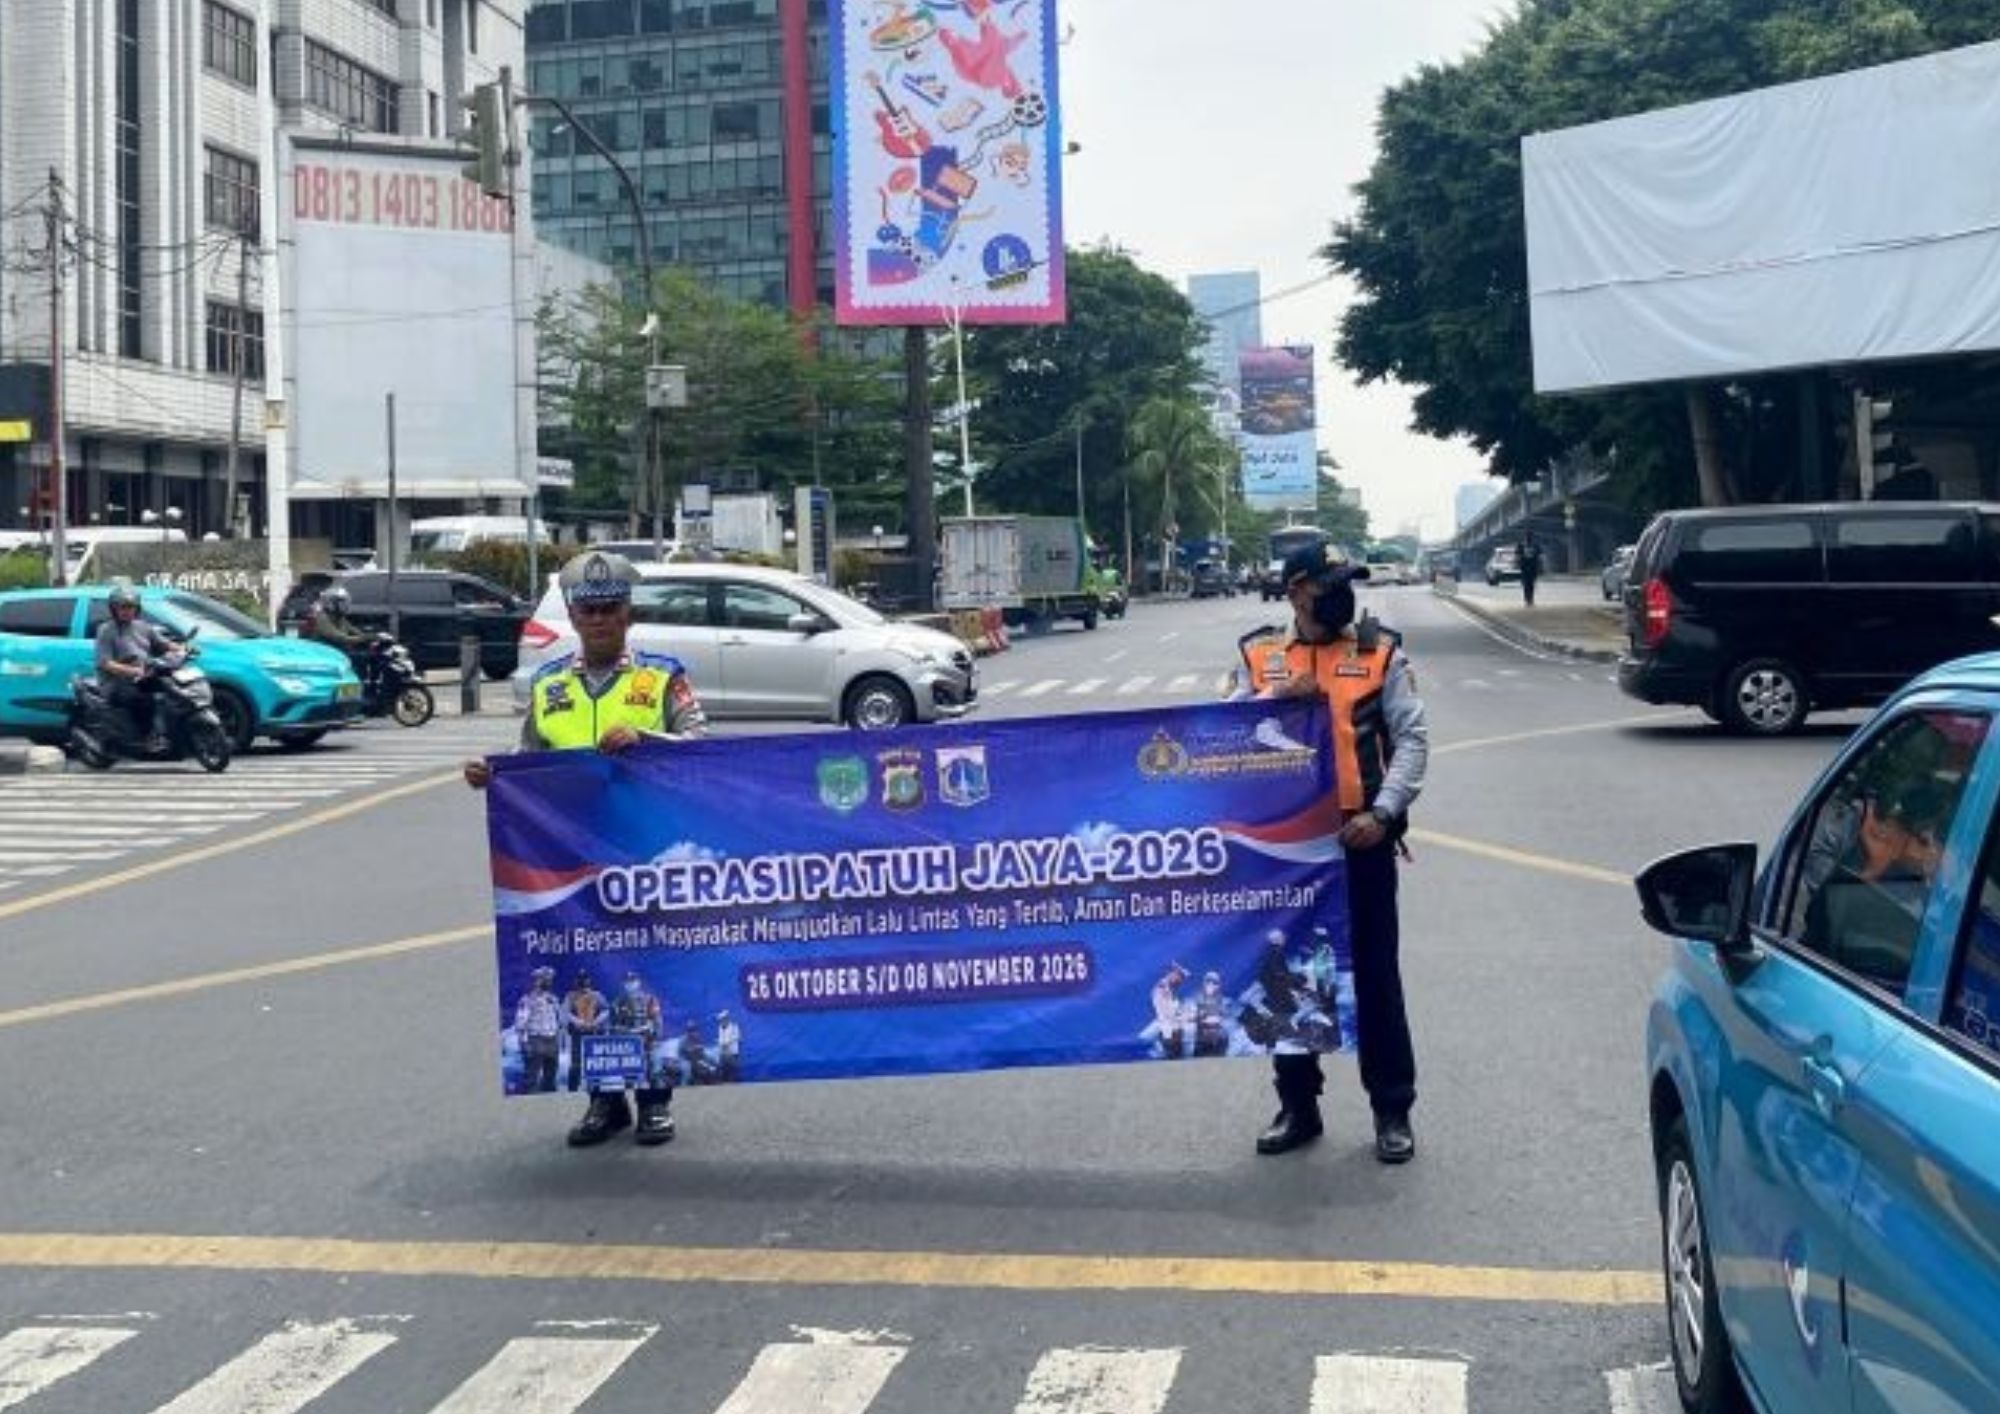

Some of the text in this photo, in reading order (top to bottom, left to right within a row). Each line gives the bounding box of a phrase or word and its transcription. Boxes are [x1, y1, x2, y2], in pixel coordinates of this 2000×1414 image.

[294, 164, 362, 224] 0813
[371, 171, 438, 229] 1403
[598, 827, 1228, 914] OPERASI PATUH JAYA-2026
[574, 925, 648, 952] Bersama
[652, 918, 748, 949] Masyarakat
[753, 910, 862, 942] Mewujudkan
[866, 908, 903, 934] Lalu
[908, 904, 960, 932] Lintas
[966, 903, 1008, 930] Yang
[1074, 896, 1127, 921] Aman
[1130, 893, 1166, 917] Dan
[747, 952, 1088, 999] 26 OKTOBER S/D 08 NOVEMBER 2026
